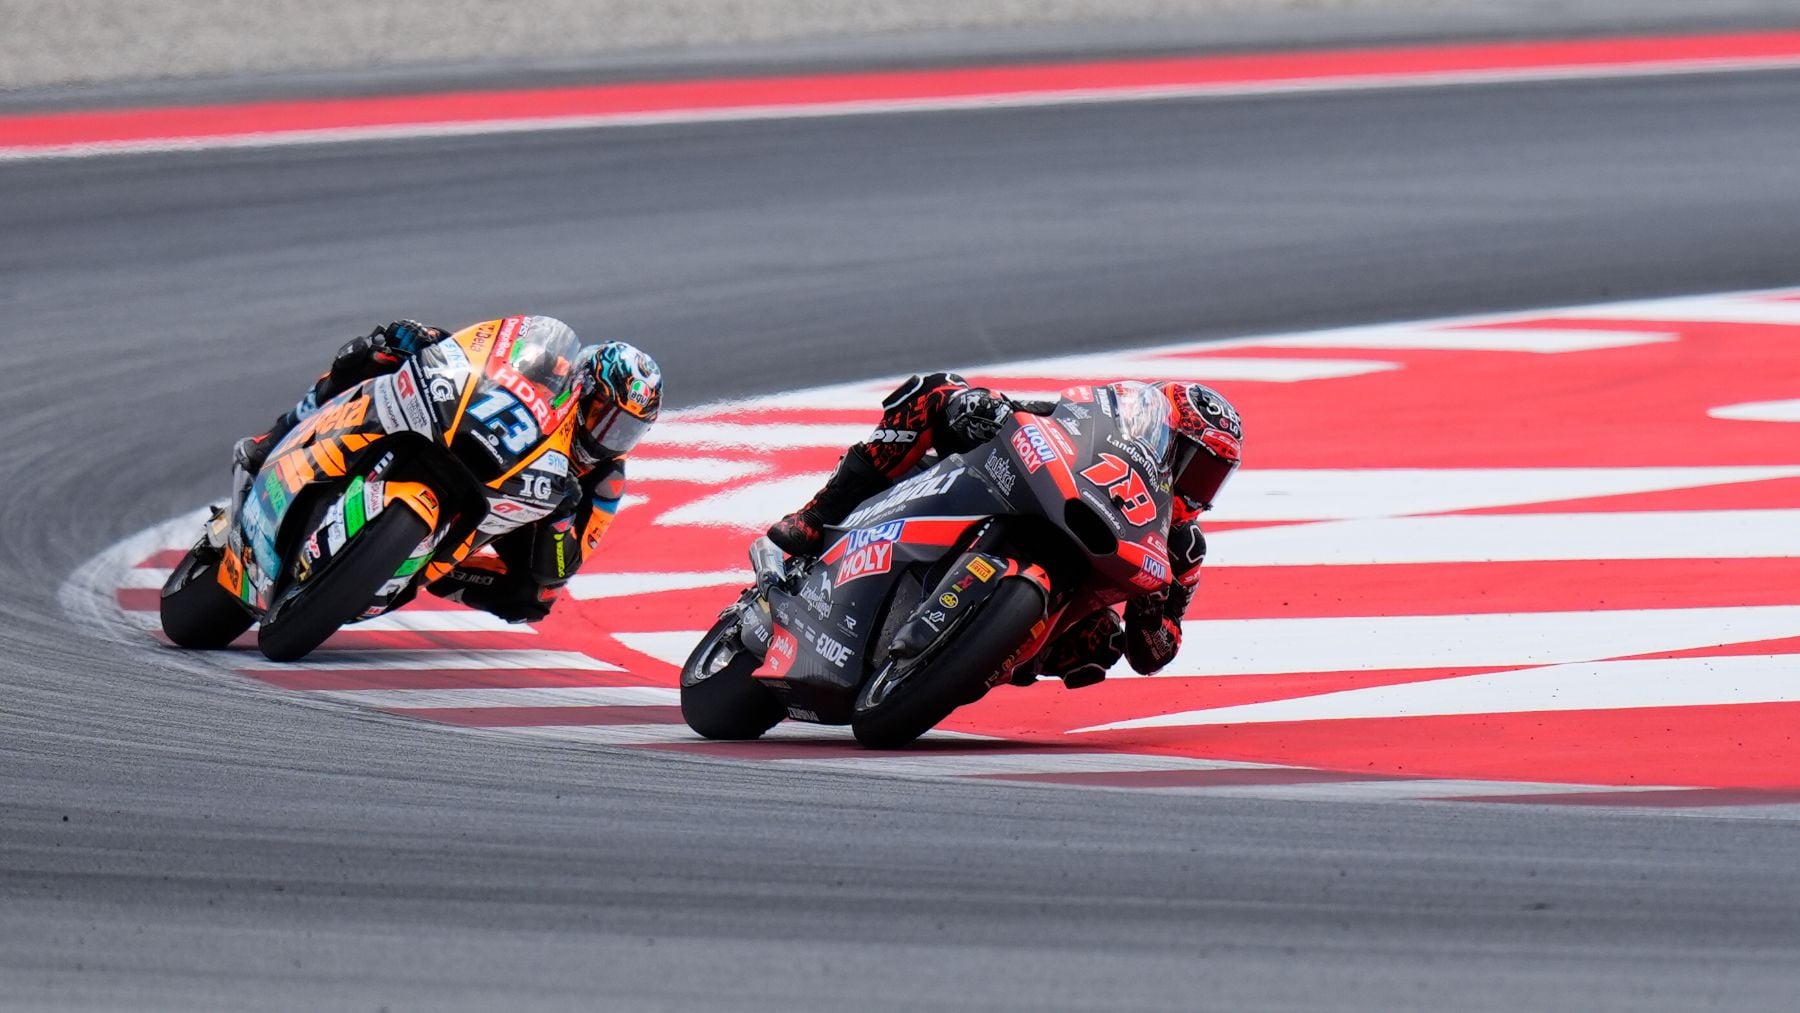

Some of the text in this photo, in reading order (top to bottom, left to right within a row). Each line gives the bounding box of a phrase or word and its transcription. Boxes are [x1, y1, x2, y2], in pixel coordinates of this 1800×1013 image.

[630, 390, 647, 404] agv
[466, 387, 539, 455] 13
[1012, 430, 1042, 468] MOLY
[1023, 426, 1056, 460] LIQUI
[1106, 434, 1160, 493] Landgeflügel
[519, 473, 552, 501] IG
[1080, 452, 1157, 527] 18
[846, 522, 902, 556] LIQUI
[837, 543, 890, 583] MOLY
[1143, 556, 1167, 580] LIQUI
[815, 632, 853, 668] EXIDE
